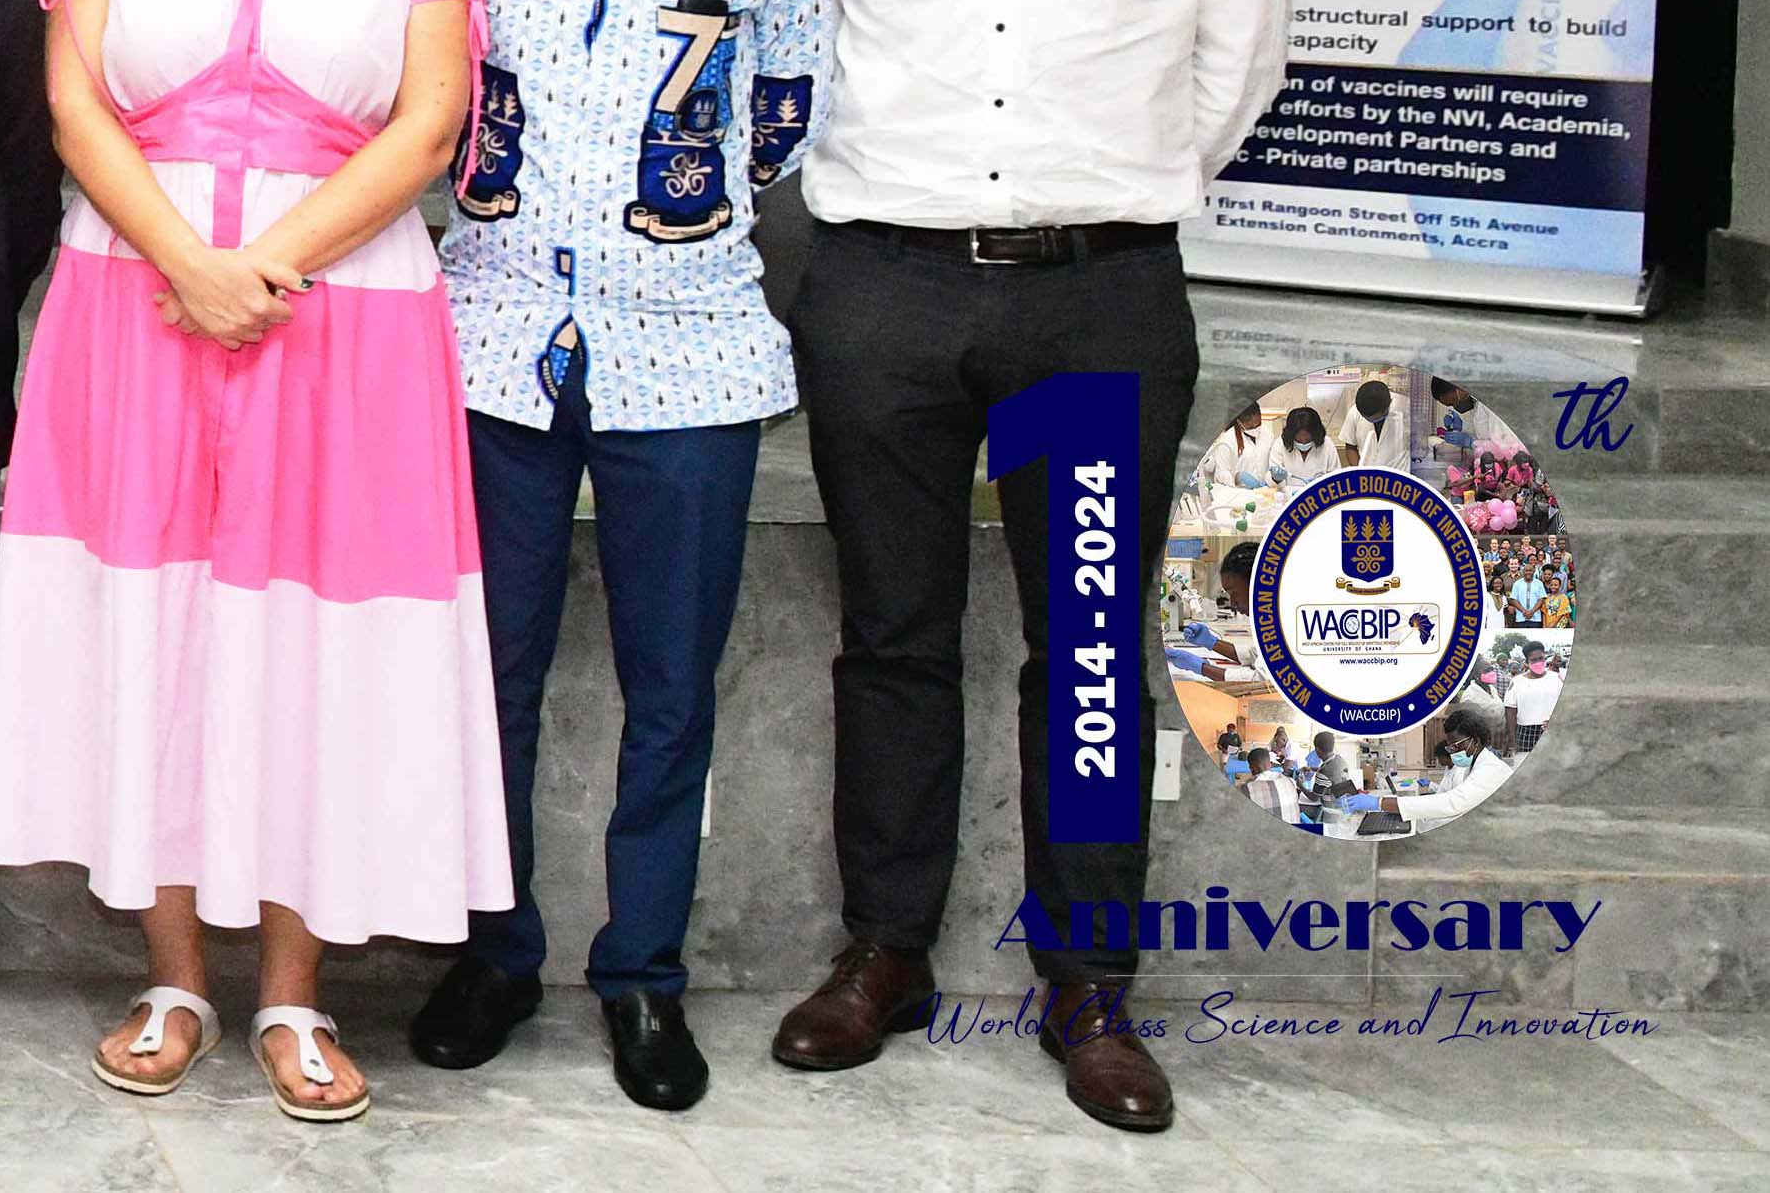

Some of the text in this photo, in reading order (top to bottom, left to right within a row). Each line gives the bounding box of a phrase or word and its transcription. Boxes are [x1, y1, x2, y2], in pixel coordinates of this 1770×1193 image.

[1293, 7, 1628, 37] structural support to build
[656, 6, 728, 115] 7
[1311, 76, 1335, 93] of
[1341, 80, 1446, 99] vaccines
[1453, 84, 1494, 102] will
[1500, 89, 1588, 109] require
[1279, 100, 1631, 140] efforts by the NVI, Academia,
[1400, 131, 1503, 154] Partners
[1510, 142, 1557, 159] and
[1353, 157, 1506, 183] partnerships
[1216, 214, 1509, 250] Extension Cantonments, Accra
[1218, 197, 1255, 210] first
[1262, 200, 1342, 218] Rangoon
[1349, 208, 1407, 223] Street
[1414, 212, 1442, 225] Off
[1450, 215, 1480, 228] 5th
[1487, 219, 1560, 236] Avenue
